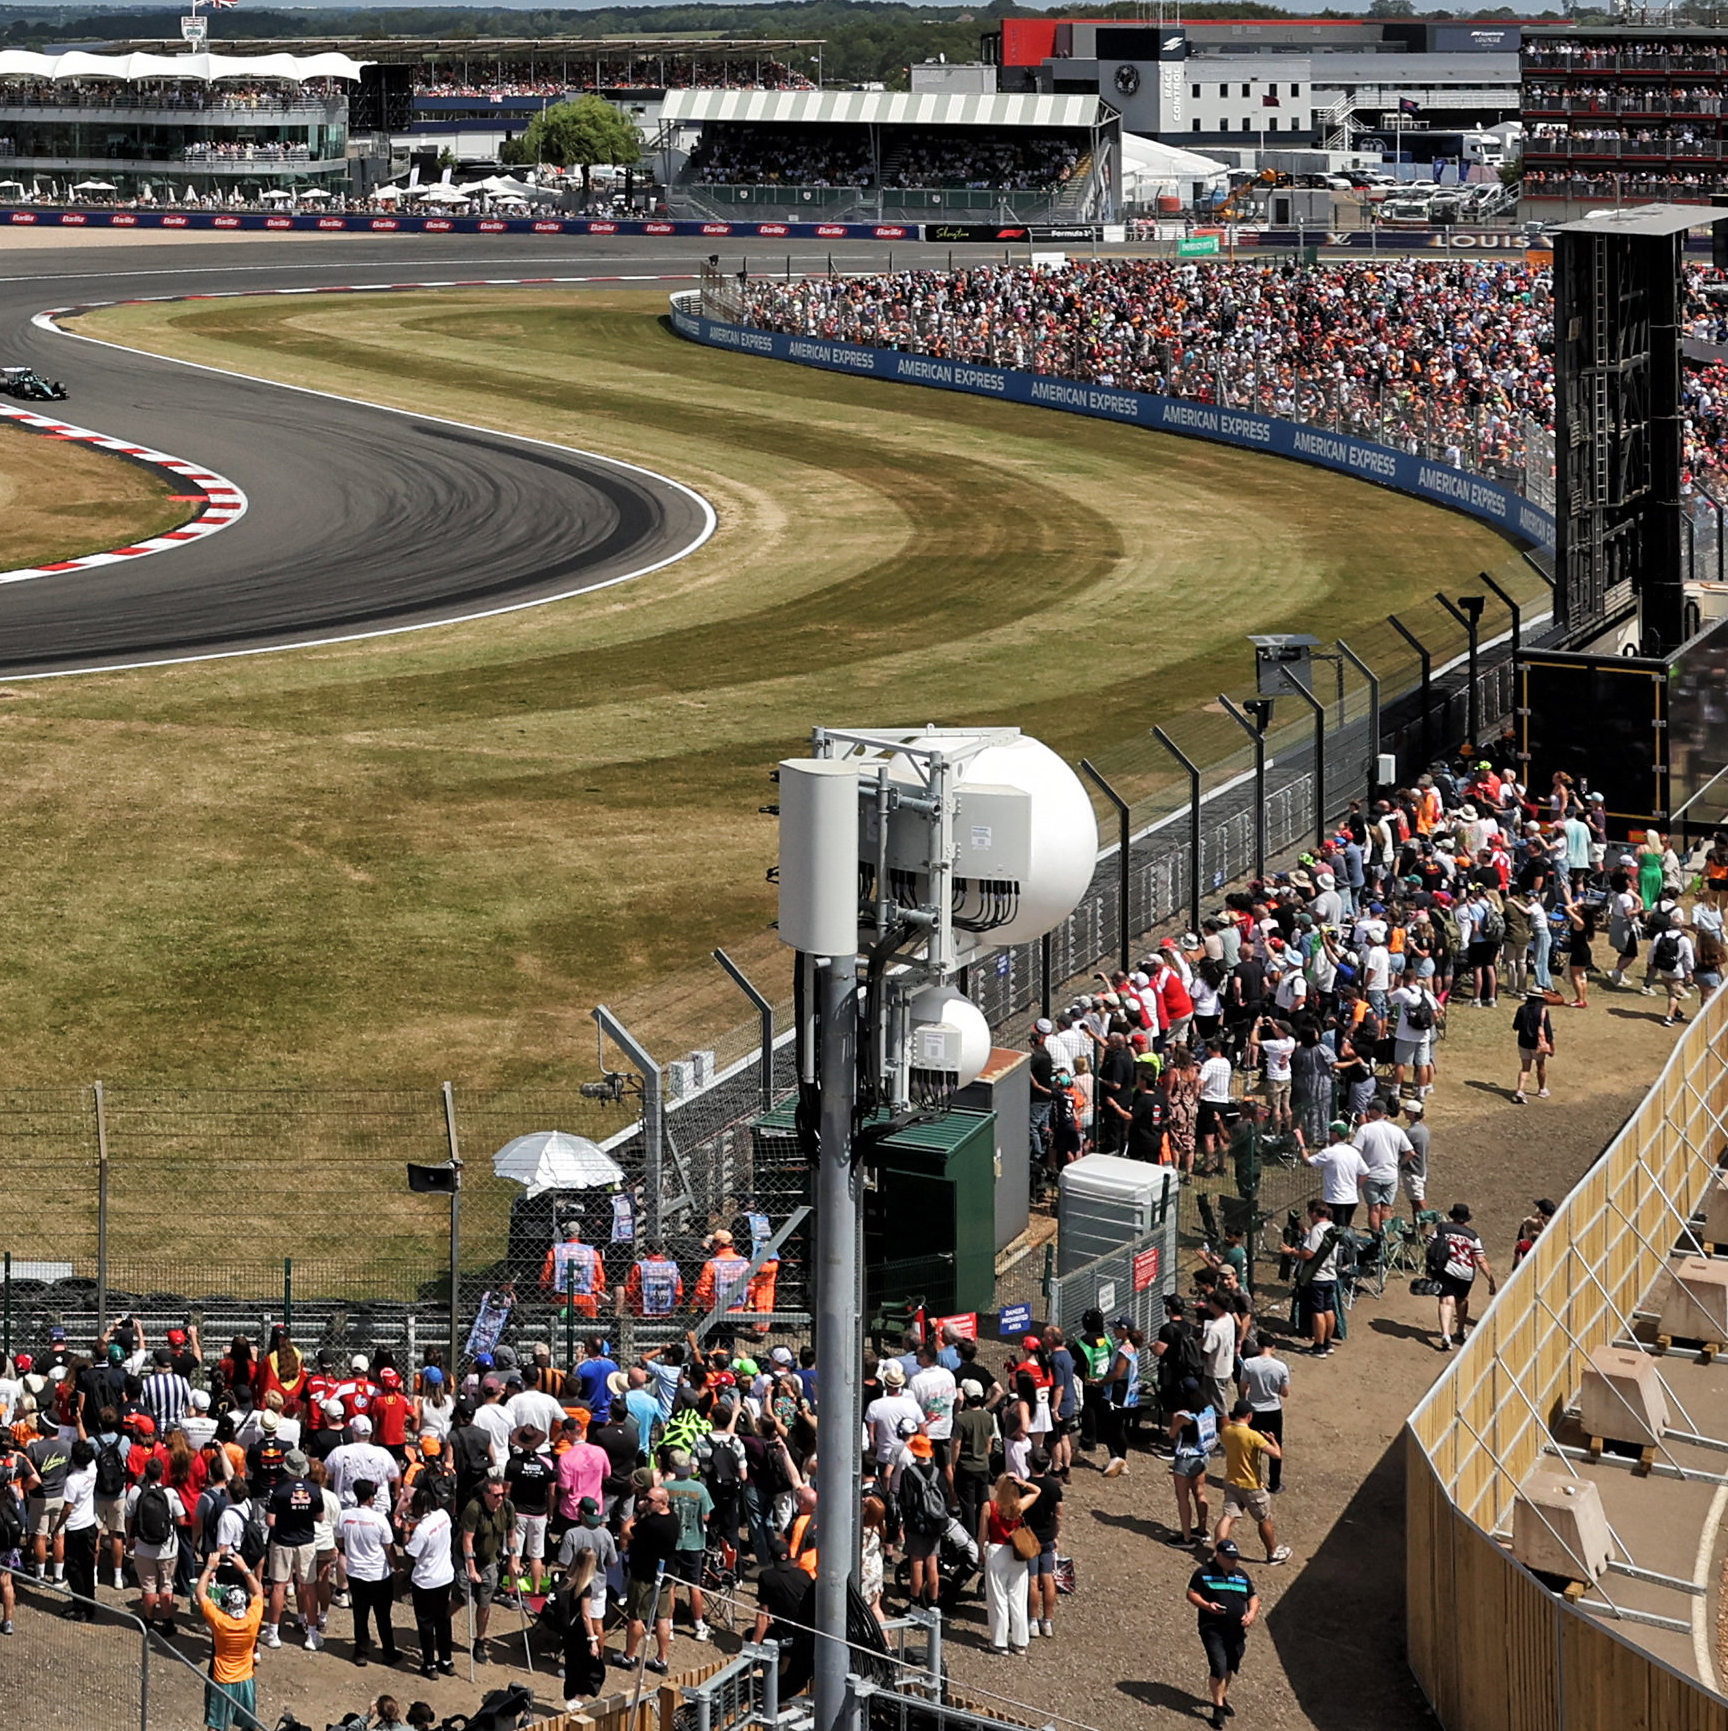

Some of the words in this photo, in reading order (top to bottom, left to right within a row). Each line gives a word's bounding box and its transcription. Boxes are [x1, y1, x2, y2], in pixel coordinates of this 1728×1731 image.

[1164, 65, 1172, 99] RACE
[1173, 68, 1181, 122] CONTROL
[12, 213, 35, 222] Barilla
[62, 214, 85, 223] Barilla
[112, 215, 135, 225] Barilla
[163, 216, 186, 226] Barilla
[215, 217, 238, 227] Barilla
[267, 218, 290, 227] Barilla
[319, 219, 343, 228] Barilla
[372, 219, 396, 229] Barilla
[426, 220, 451, 230] Barilla
[480, 221, 504, 231] Barilla
[535, 222, 559, 232] Barilla
[590, 223, 615, 232] Barilla
[646, 223, 671, 233] Barilla
[702, 224, 728, 234] Barilla
[759, 225, 786, 236] Barilla
[817, 226, 844, 236] Barilla
[876, 226, 903, 237] Barilla
[1051, 230, 1081, 238] Formula
[1436, 233, 1529, 249] LOUIS
[708, 326, 740, 346] AMERICAN
[741, 332, 773, 352] EXPRESS
[789, 341, 832, 364] AMERICAN
[832, 348, 875, 369] EXPRESS
[897, 358, 953, 382] AMERICAN
[955, 368, 1006, 392] EXPRESS
[1030, 381, 1088, 406] AMERICAN
[1090, 392, 1138, 417] EXPRESS
[1162, 404, 1219, 432] AMERICAN
[1221, 418, 1271, 442] EXPRESS
[1292, 430, 1347, 463] AMERICAN
[1348, 445, 1396, 477] EXPRESS
[1418, 465, 1471, 501] AMERICAN
[1471, 481, 1507, 517] EXPRESS
[1004, 1306, 1026, 1316] DANGER
[1001, 1313, 1029, 1325] PROHIBITED
[1008, 1322, 1022, 1331] AREA
